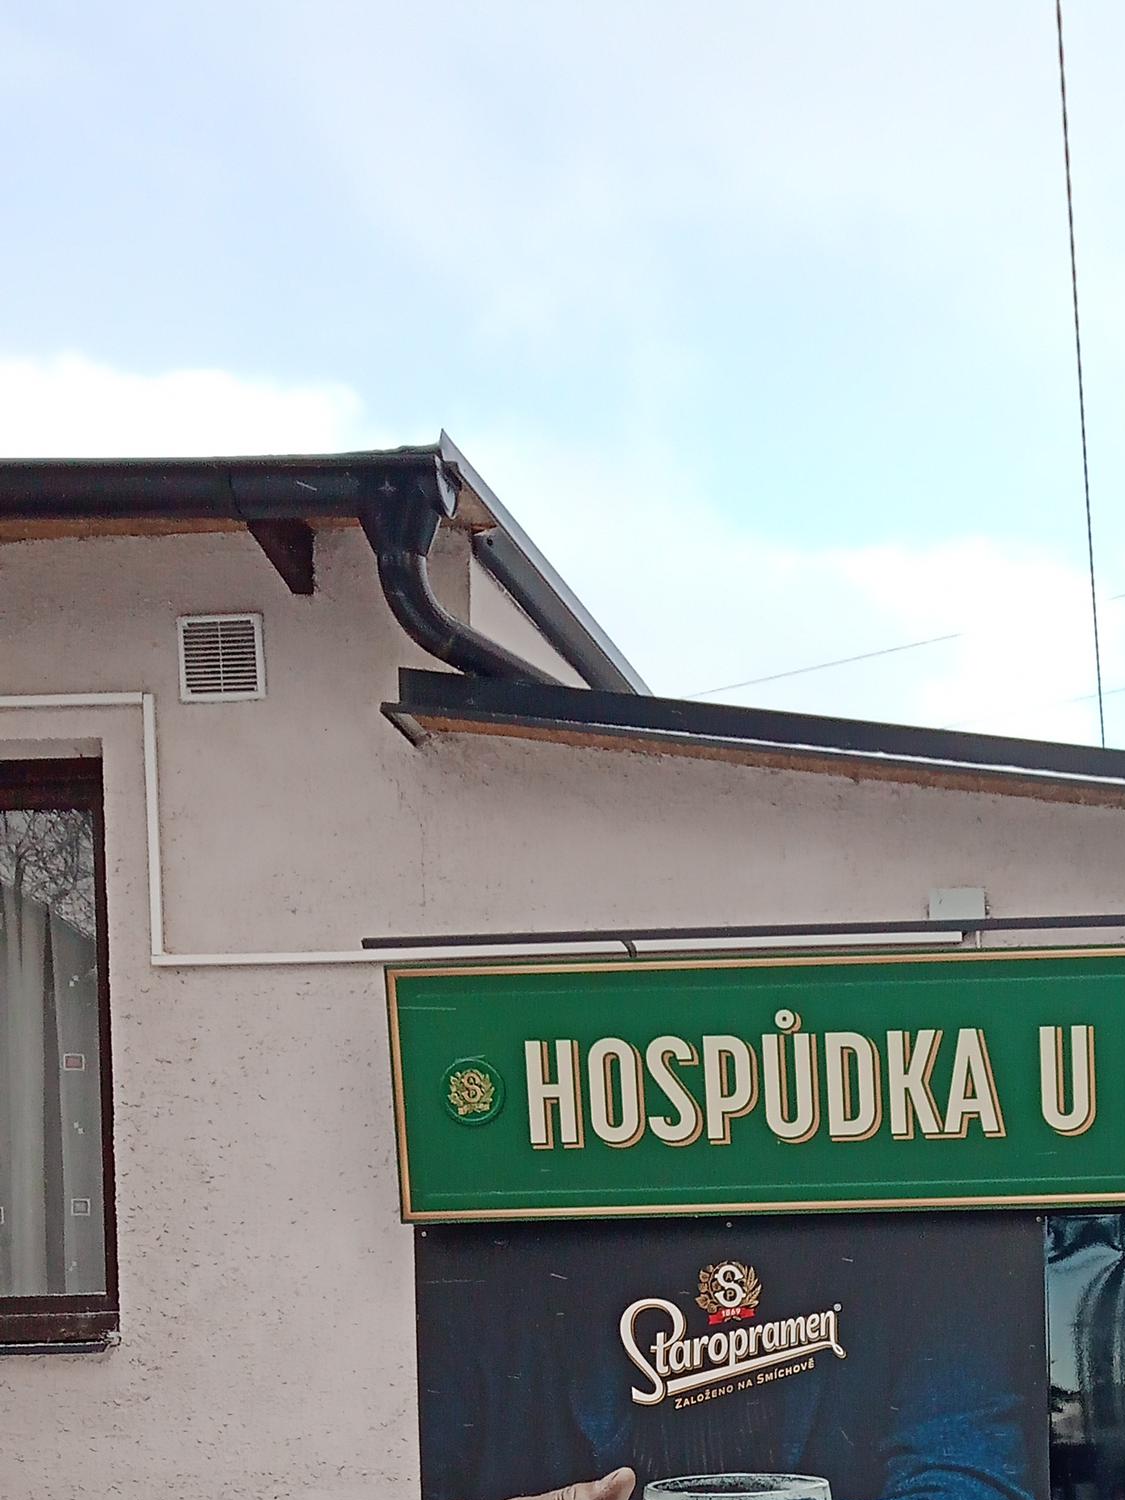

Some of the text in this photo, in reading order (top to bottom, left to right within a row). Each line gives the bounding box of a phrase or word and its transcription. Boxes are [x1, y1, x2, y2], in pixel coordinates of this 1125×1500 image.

[524, 1008, 1006, 1149] HOSPŮDKA
[1039, 1023, 1096, 1137] U
[737, 1378, 753, 1391] NA
